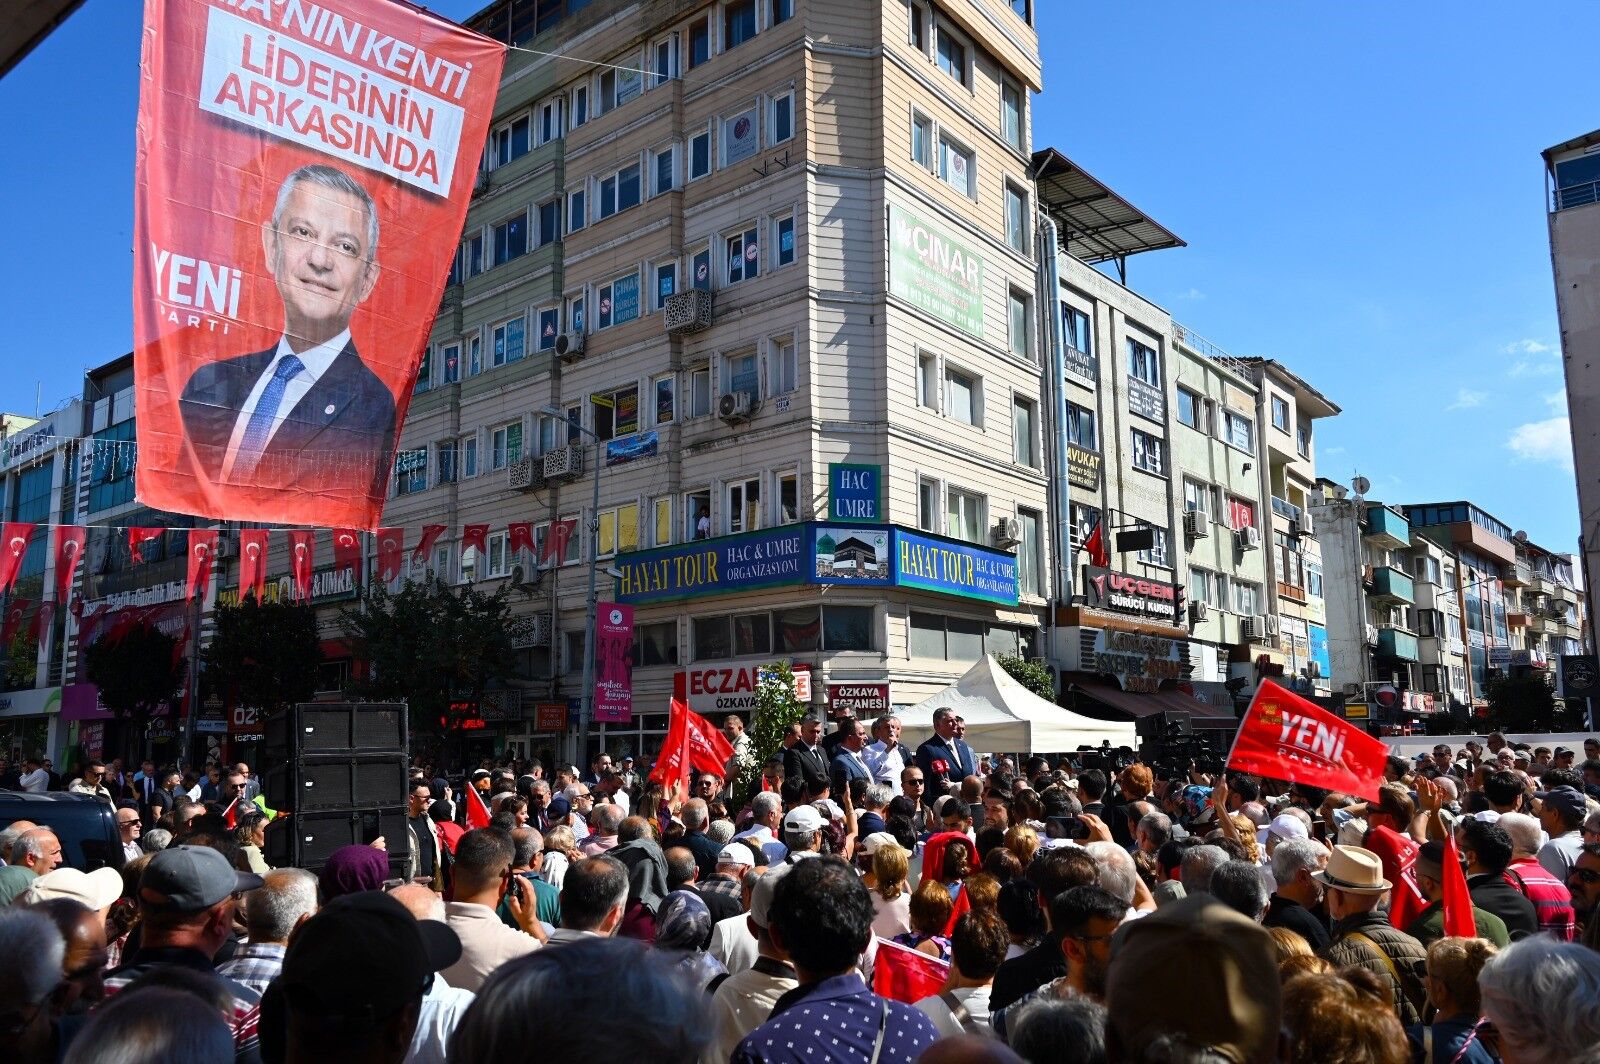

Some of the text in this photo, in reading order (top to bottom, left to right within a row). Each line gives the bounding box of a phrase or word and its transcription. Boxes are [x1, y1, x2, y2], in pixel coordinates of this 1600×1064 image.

[360, 29, 473, 99] KENTİ
[241, 33, 434, 141] LİDERİNİN
[214, 72, 440, 185] ARKASINDA
[152, 241, 242, 319] YENİ
[1067, 447, 1100, 470] AVUKAT
[841, 470, 870, 490] HAC
[836, 498, 876, 518] UMRE
[727, 536, 800, 564] HAC & UMRE
[900, 540, 974, 587] HAYAT TOUR
[321, 567, 353, 597] UMRE
[620, 551, 719, 596] HAYAT TOUR
[976, 557, 990, 575] HAC
[996, 562, 1015, 580] UMRE
[1110, 572, 1175, 600] ÜÇGEN
[1110, 593, 1175, 616] SÜRÜCÜ KURSU
[838, 686, 880, 697] ÖZKAYA
[1279, 710, 1348, 763] YENİ
